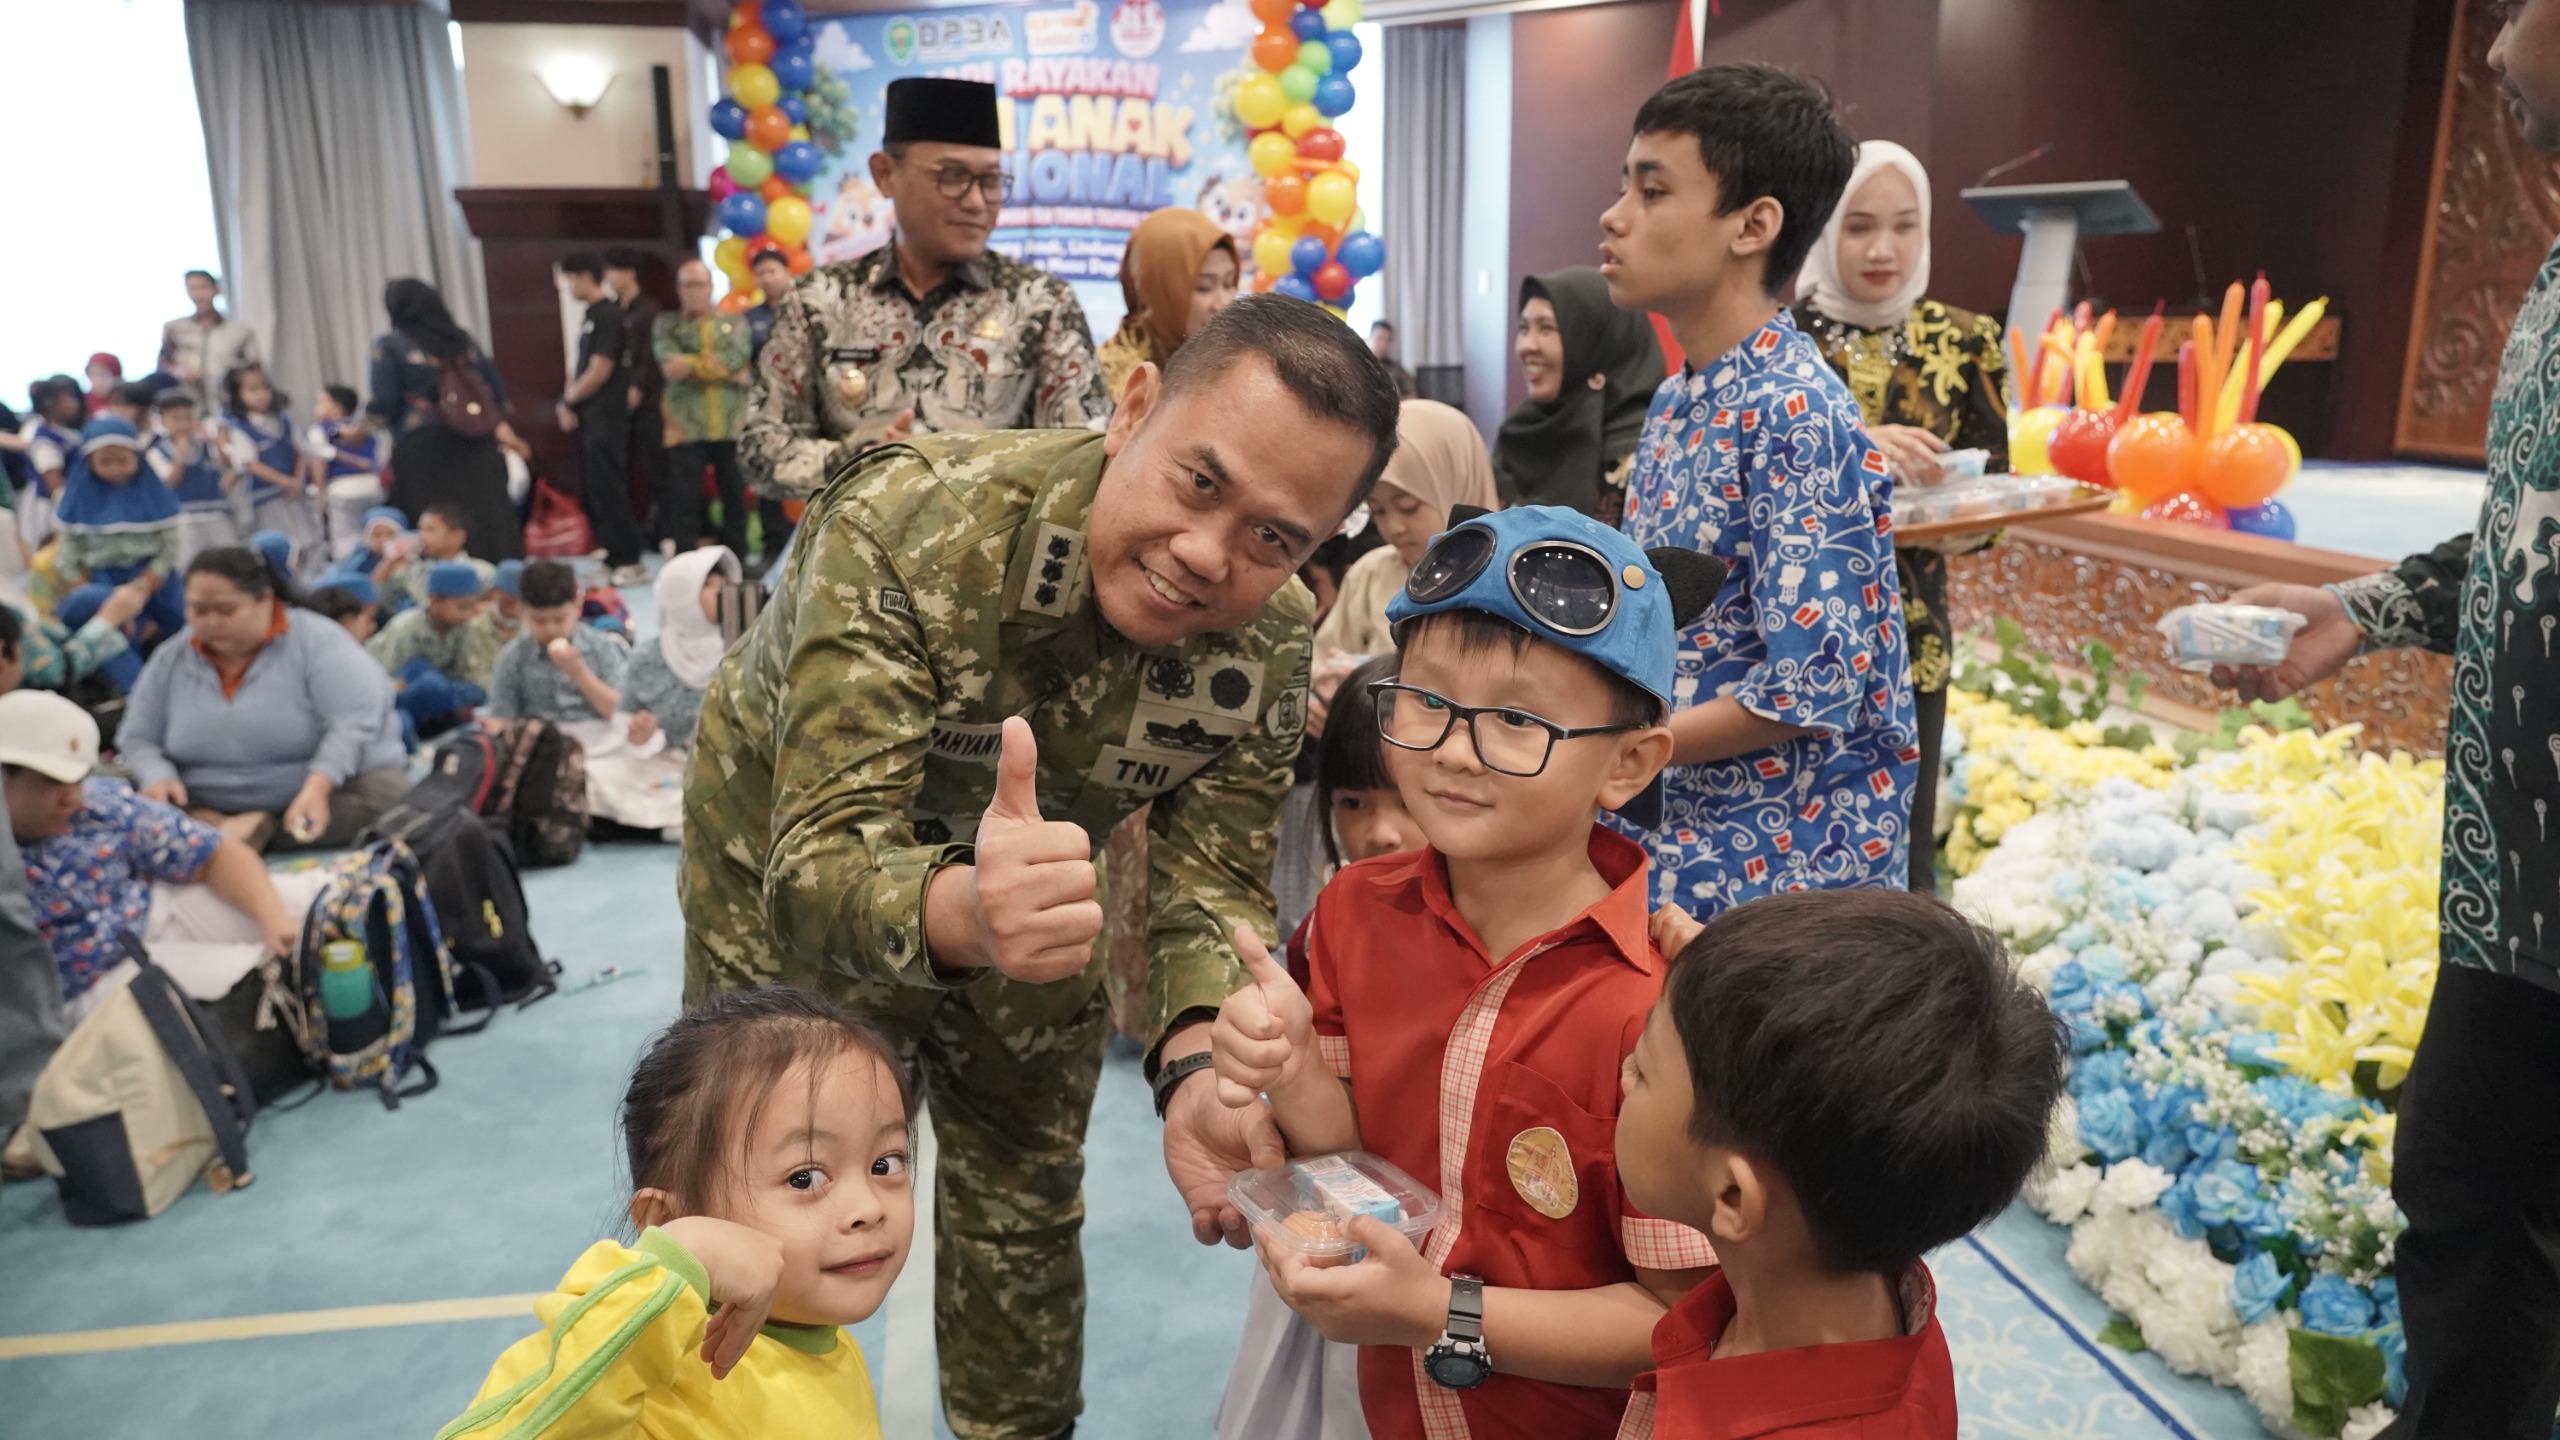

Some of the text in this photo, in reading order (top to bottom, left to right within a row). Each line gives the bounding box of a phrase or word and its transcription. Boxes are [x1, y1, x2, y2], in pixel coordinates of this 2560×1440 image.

[1003, 58, 1159, 99] RAYAKAN
[1029, 94, 1194, 168] ANAK
[1001, 149, 1175, 206] IONAL
[1117, 759, 1170, 787] TNI
